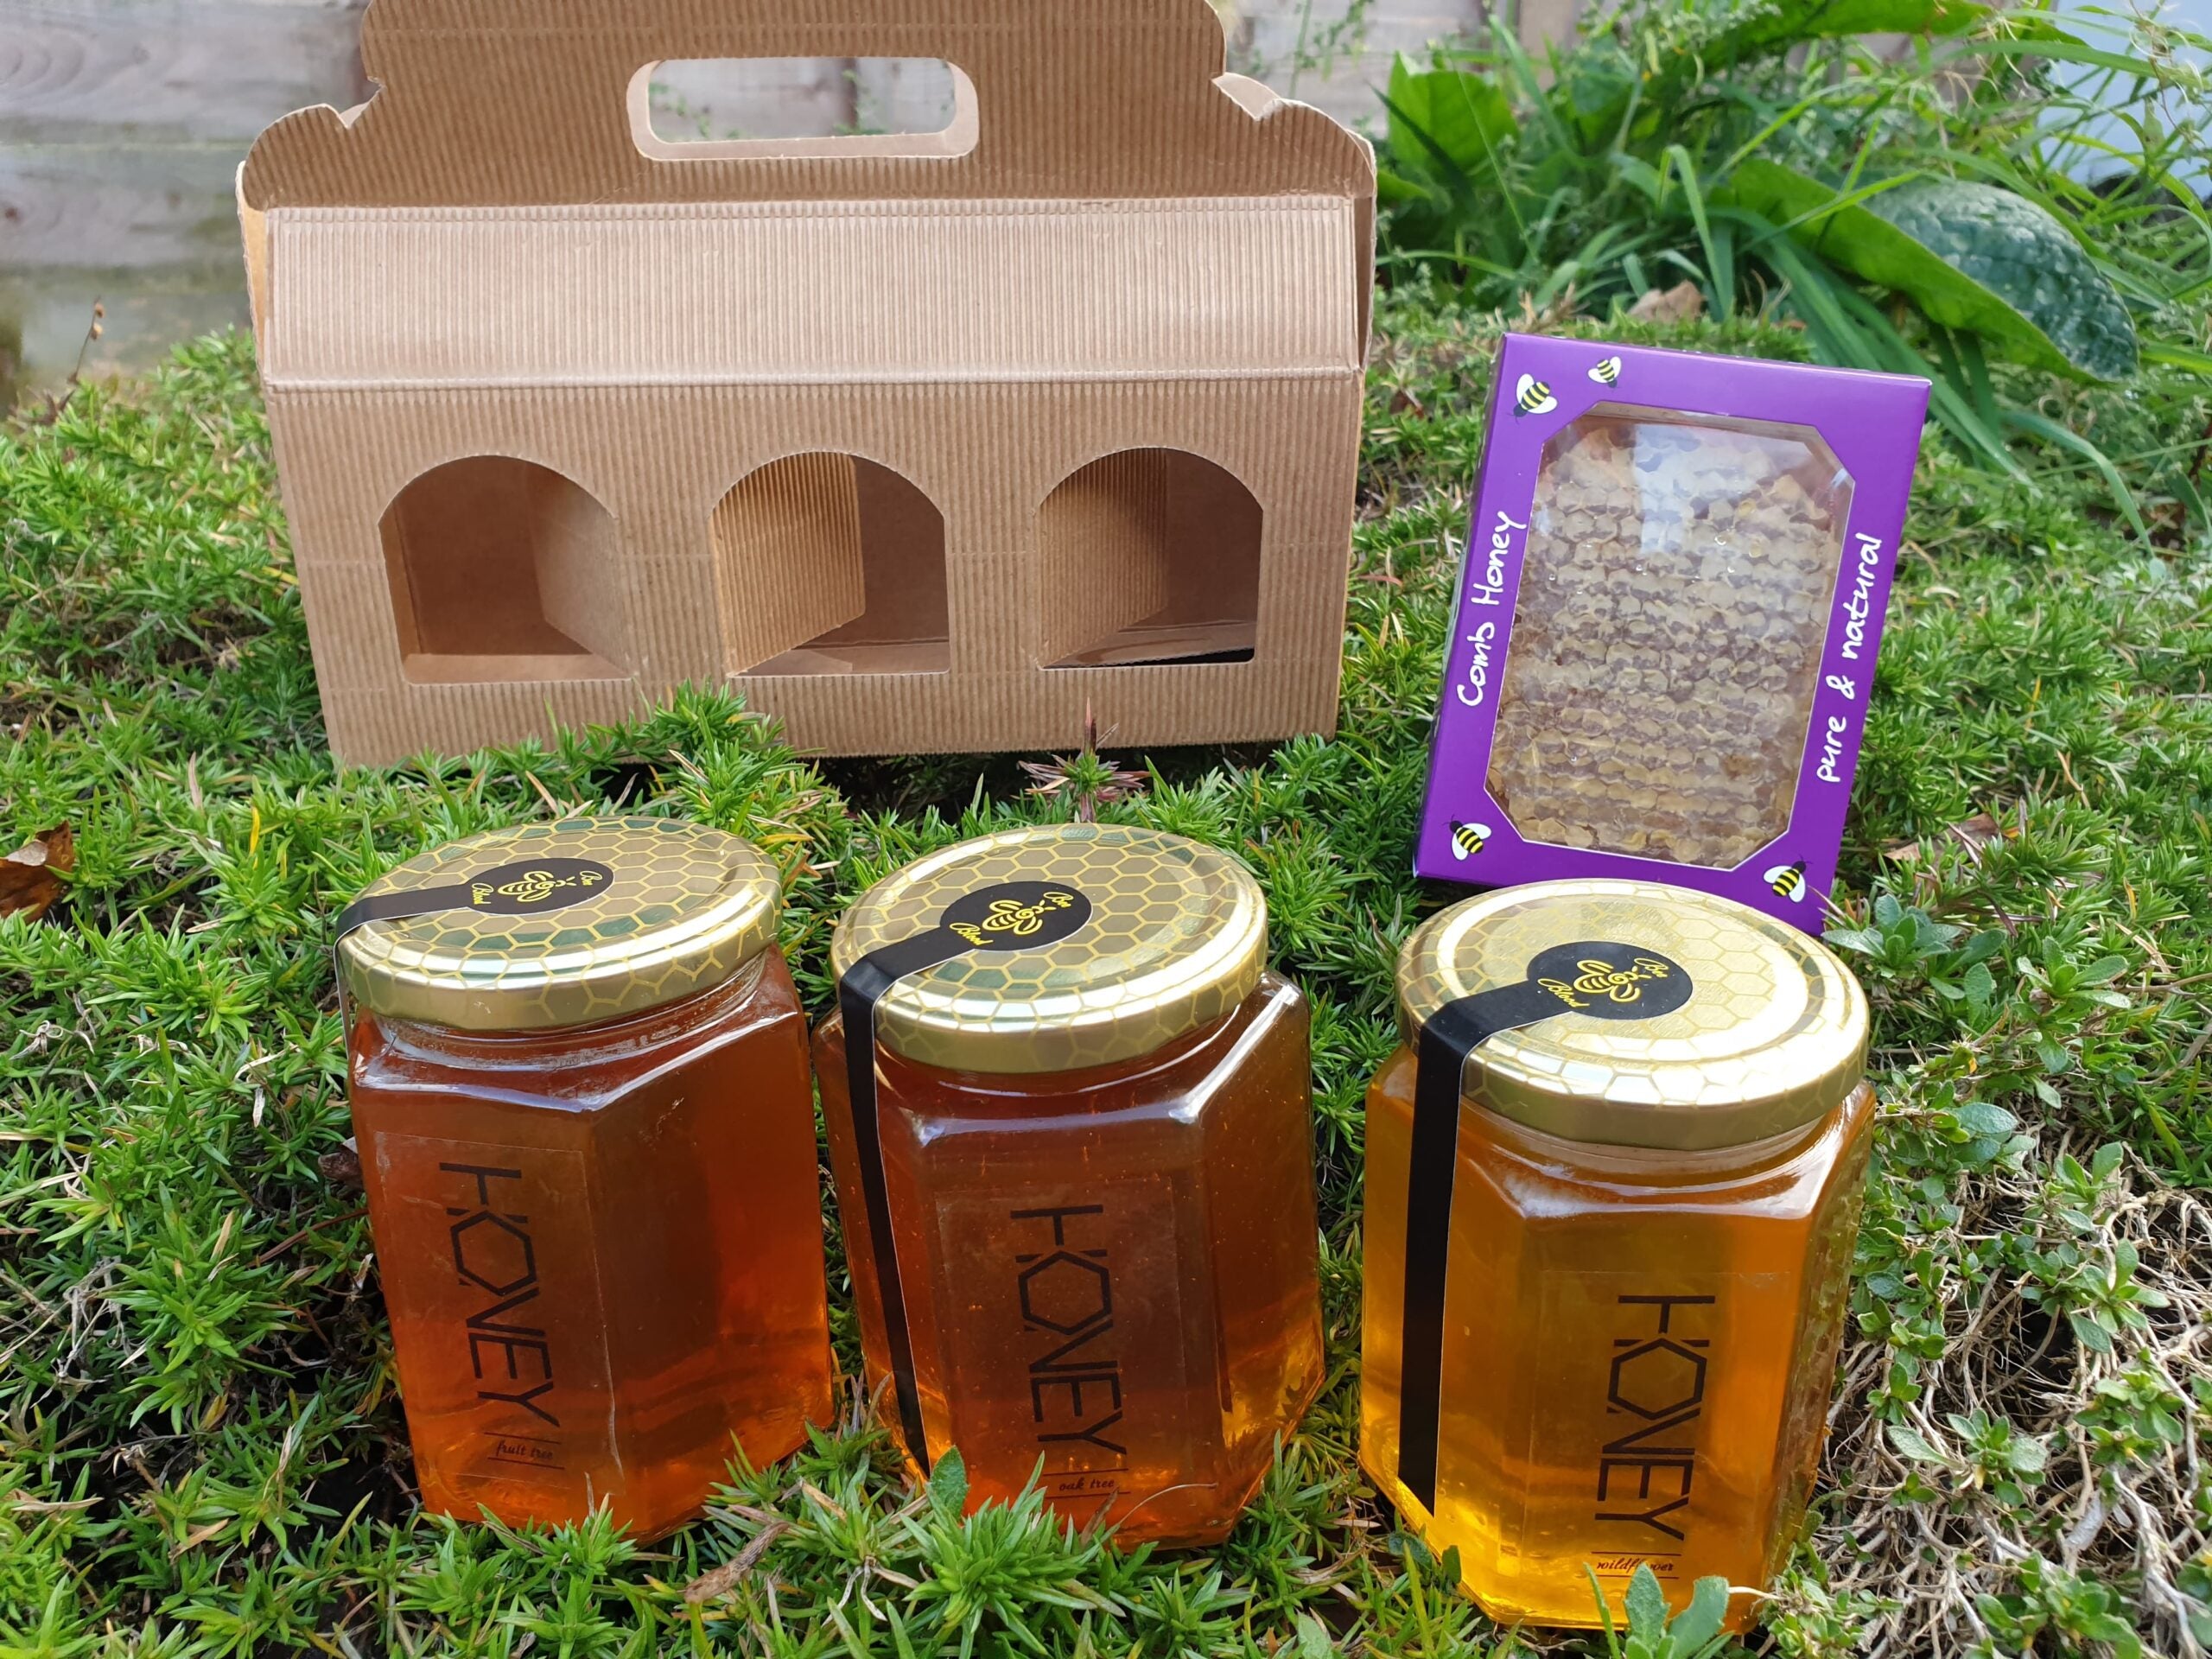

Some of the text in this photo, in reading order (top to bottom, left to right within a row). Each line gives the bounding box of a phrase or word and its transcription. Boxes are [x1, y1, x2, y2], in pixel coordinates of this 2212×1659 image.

[1456, 510, 1528, 707] Comb Honey
[1815, 531, 1883, 783] pure & natural
[949, 922, 994, 946] Blood
[1537, 978, 1591, 1008] Blood
[438, 1161, 561, 1428] HONEY
[1009, 1204, 1128, 1456] HONEY
[495, 1439, 526, 1458] fruit
[1594, 1294, 1716, 1542] HONEY
[1058, 1476, 1115, 1491] oak tree
[1596, 1557, 1675, 1573] wildfwer
